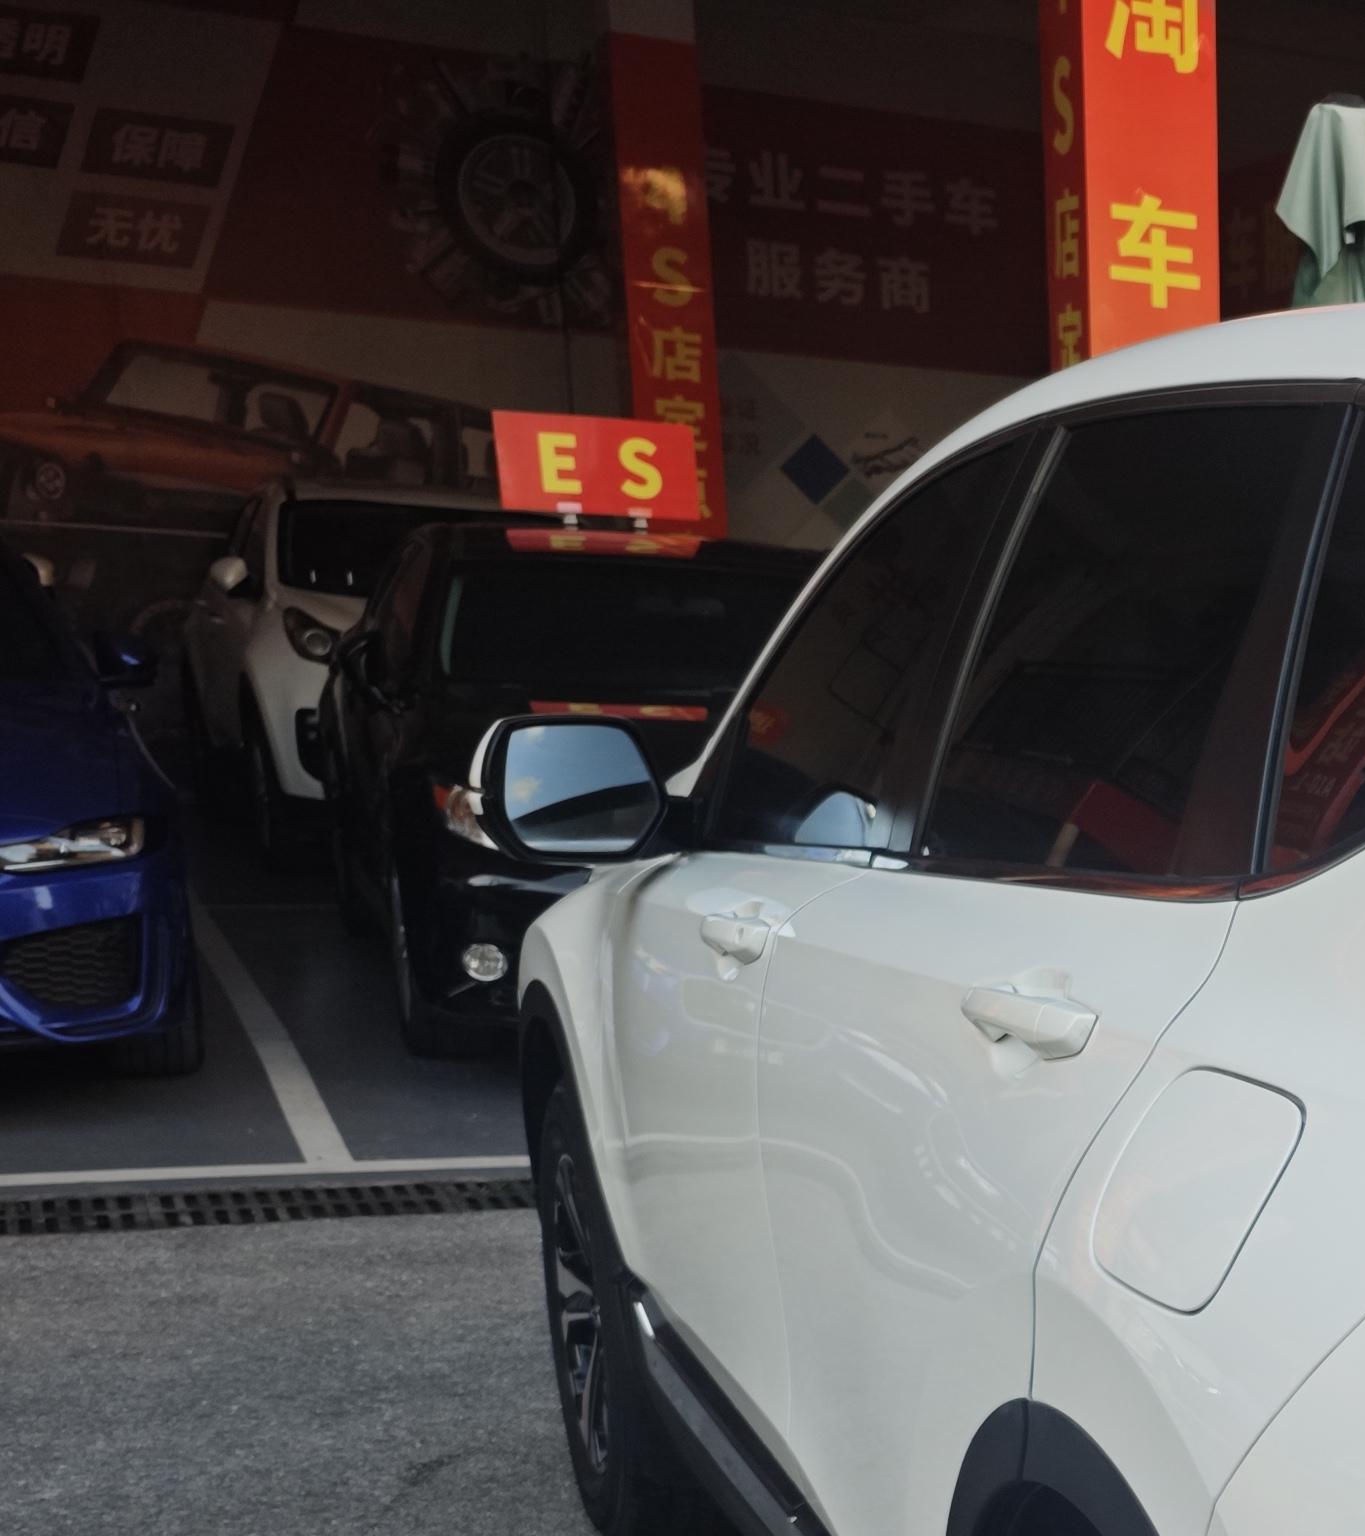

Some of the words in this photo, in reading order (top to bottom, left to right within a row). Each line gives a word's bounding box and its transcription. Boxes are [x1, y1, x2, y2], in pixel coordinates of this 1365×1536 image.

[111, 122, 208, 173] 保障
[86, 206, 182, 253] 无忧
[745, 238, 930, 314] 服务商
